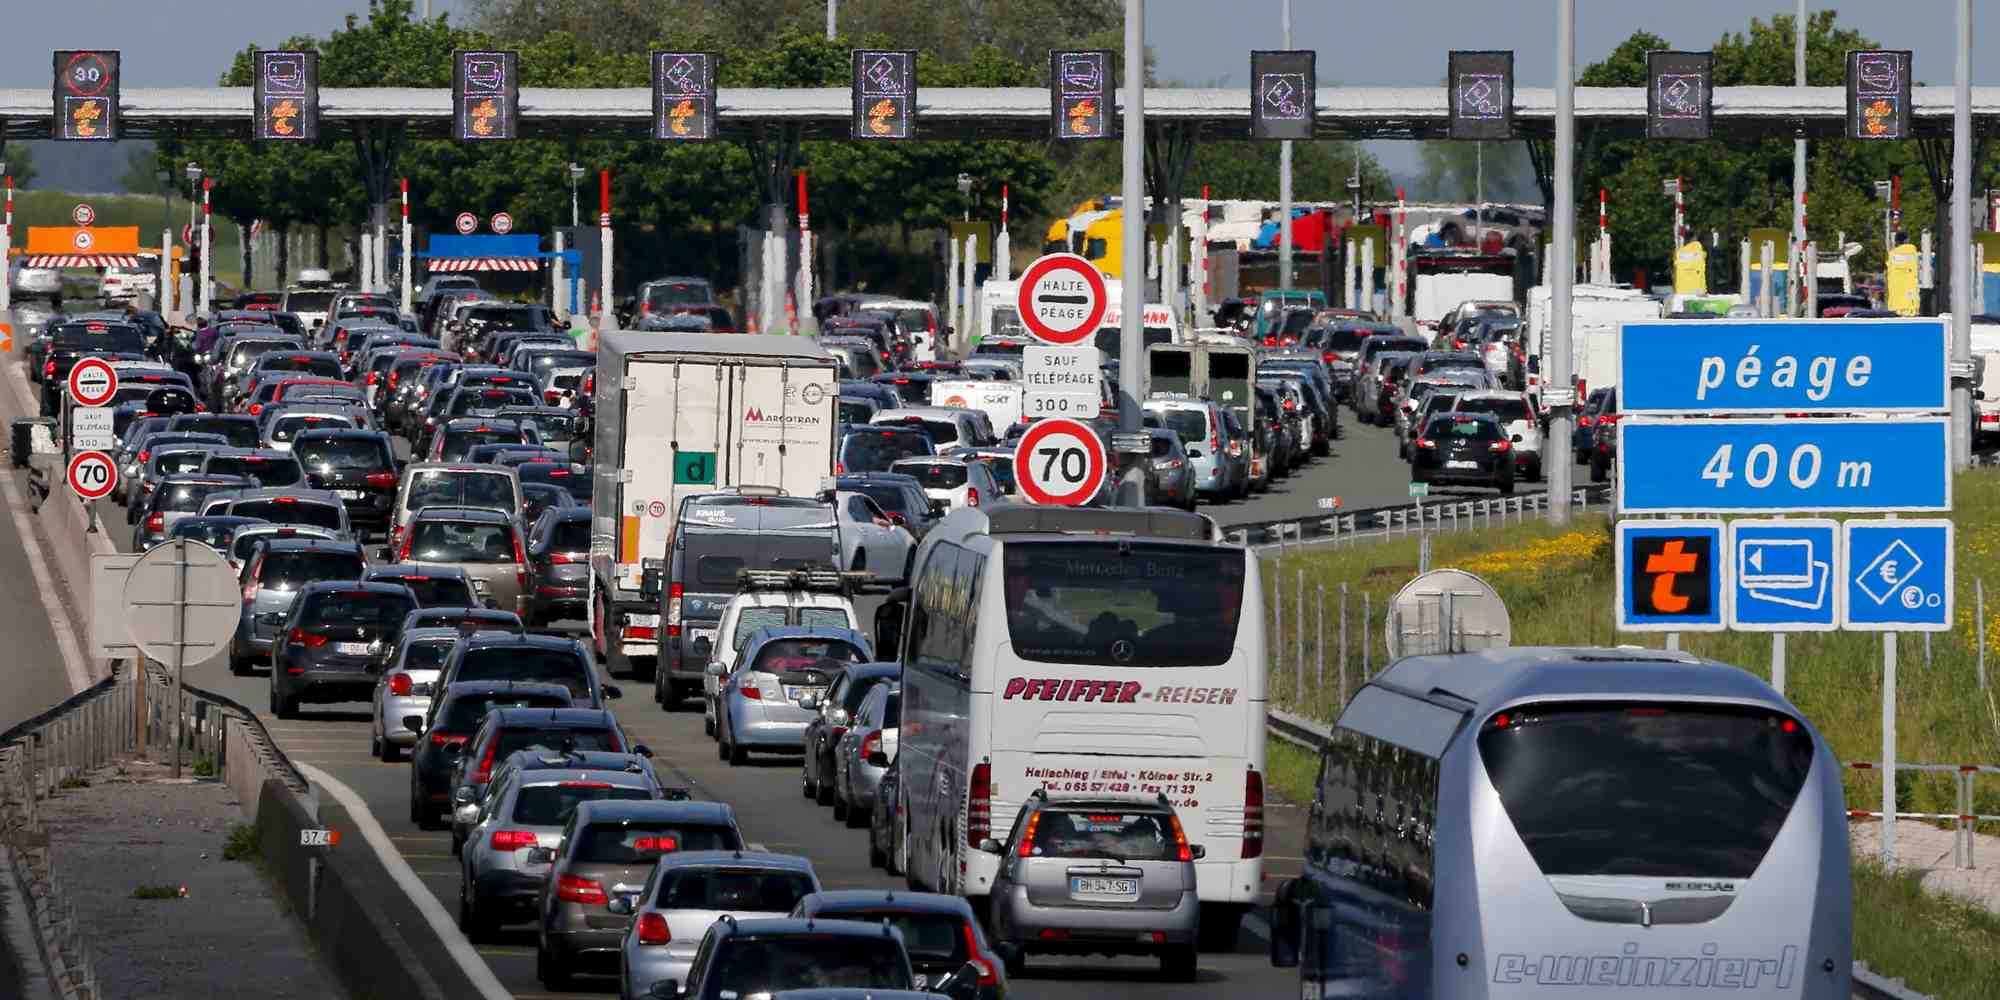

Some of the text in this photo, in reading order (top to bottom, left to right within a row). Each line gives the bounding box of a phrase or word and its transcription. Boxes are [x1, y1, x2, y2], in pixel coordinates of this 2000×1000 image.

[74, 67, 100, 82] 30
[1043, 280, 1085, 292] HALTE
[1041, 306, 1085, 320] PÉAGE
[1044, 355, 1080, 367] SAUF
[1027, 371, 1095, 385] TÉLÉPÉAGE
[1696, 345, 1873, 401] péage
[1035, 398, 1089, 412] 300 m
[80, 439, 98, 447] 300
[1038, 447, 1087, 484] 70
[1702, 444, 1873, 489] 400 m
[80, 464, 108, 484] 70
[1183, 772, 1203, 782] Str.
[1205, 773, 1213, 782] 2
